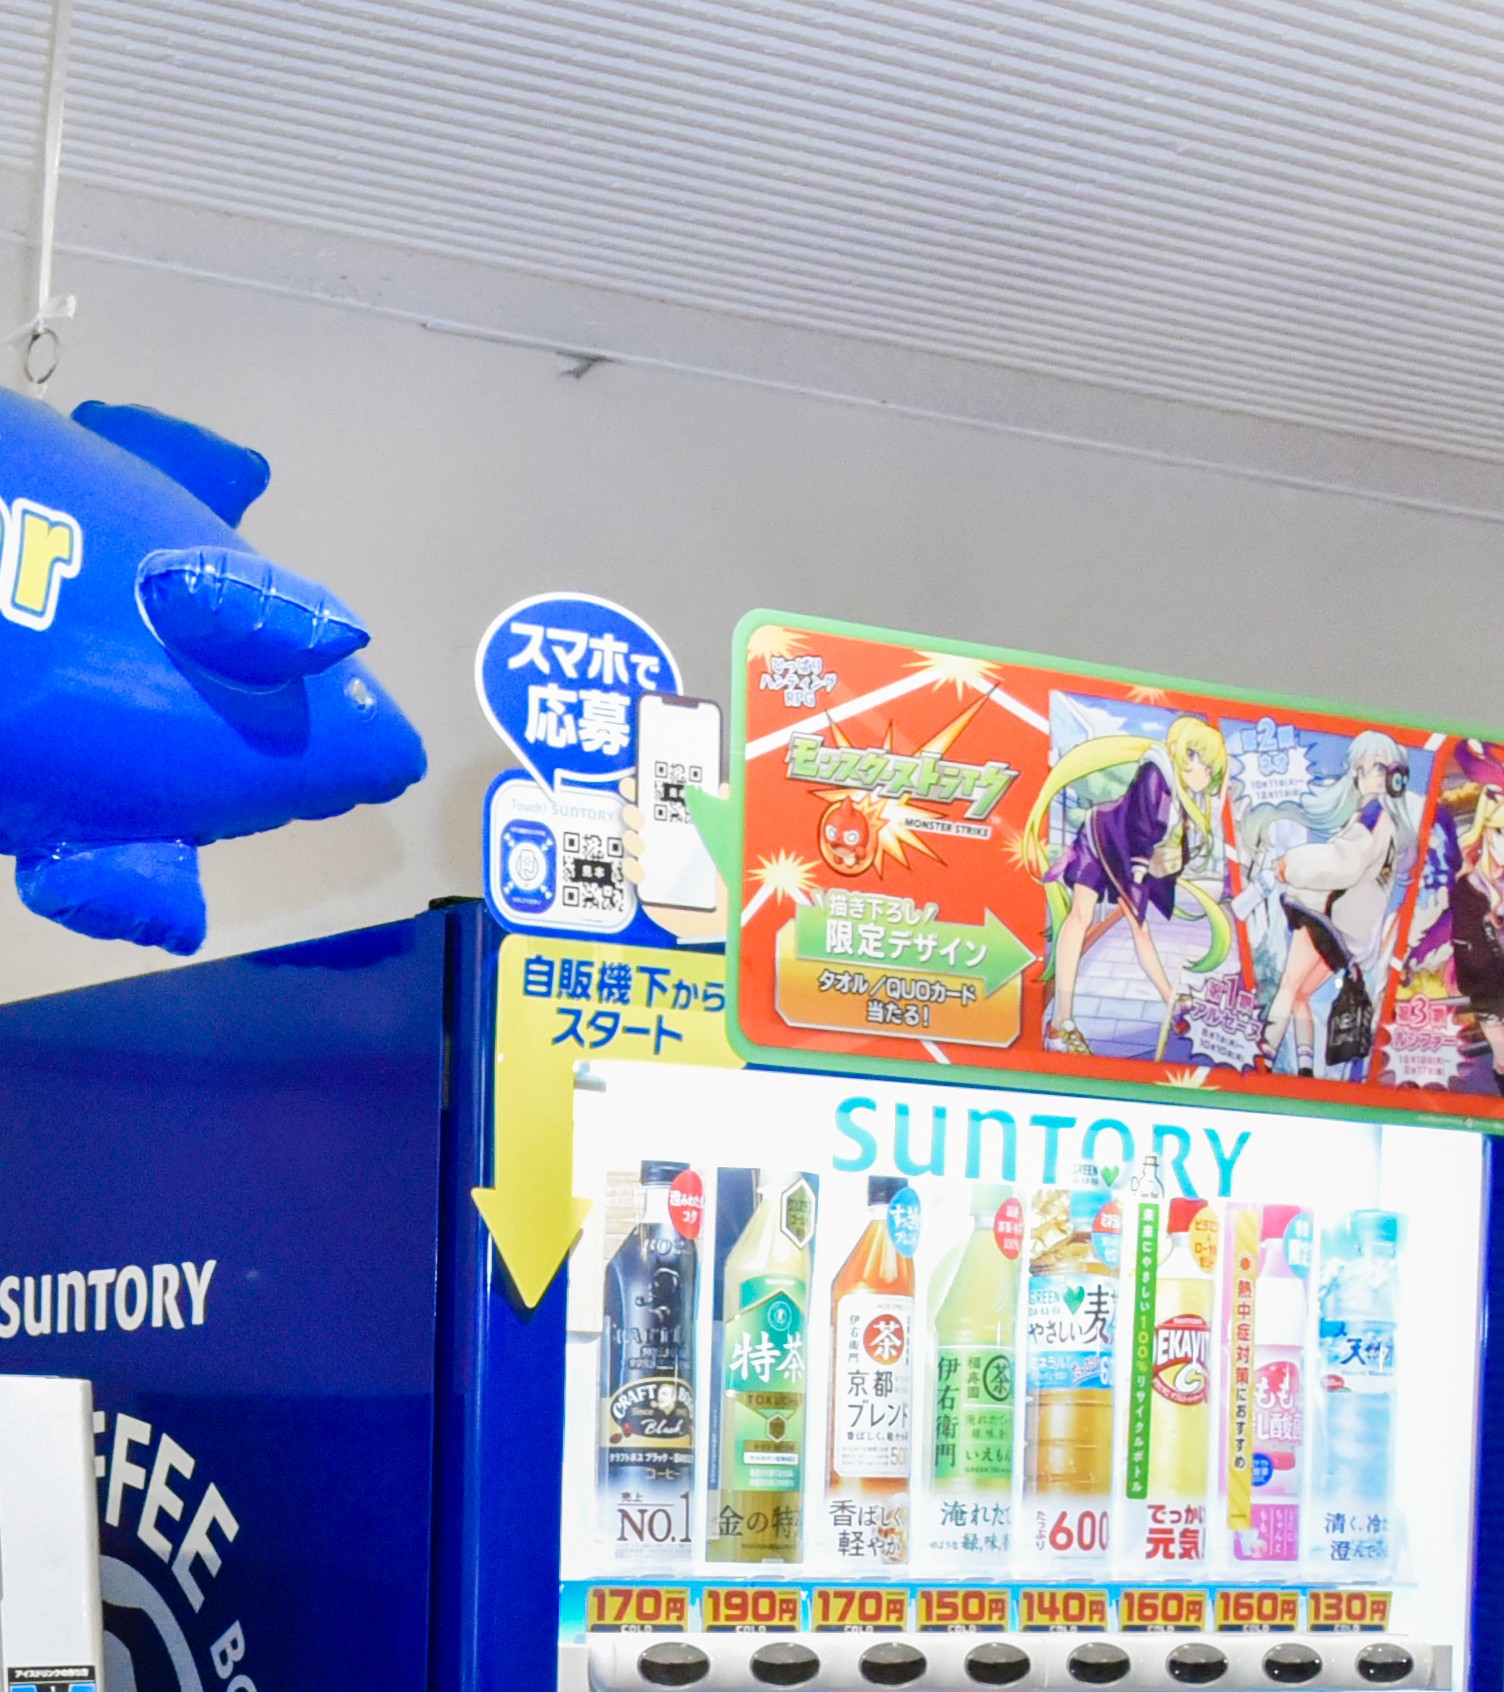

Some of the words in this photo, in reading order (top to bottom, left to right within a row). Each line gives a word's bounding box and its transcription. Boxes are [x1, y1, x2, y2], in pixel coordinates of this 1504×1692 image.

[507, 621, 660, 690] スマホで
[524, 682, 631, 756] 応募
[552, 801, 617, 821] SUNTORY
[904, 816, 950, 835] MONSTER
[954, 824, 991, 839] STRIKE
[824, 920, 988, 966] 限定デザイン
[521, 955, 727, 1014] 自販機下から
[551, 1008, 684, 1055] スタート
[832, 1094, 1252, 1200] SUNTORY
[729, 1331, 805, 1383] 特茶
[870, 1321, 901, 1360] 茶
[848, 1369, 893, 1397] 京都
[613, 1385, 657, 1420] CRAFT
[935, 1357, 961, 1469] 伊右衛門
[617, 1491, 692, 1543] NO.1
[829, 1499, 904, 1527] 香ばしく
[837, 1531, 901, 1557] 軽やか
[592, 1589, 685, 1622] 170円
[707, 1589, 797, 1622] 190円
[817, 1590, 904, 1622] 170円
[921, 1590, 1007, 1622] 150円
[1022, 1591, 1106, 1622] 140円
[1124, 1591, 1202, 1622] 160円
[1219, 1592, 1296, 1622] 160円
[1310, 1592, 1387, 1622] 130円
